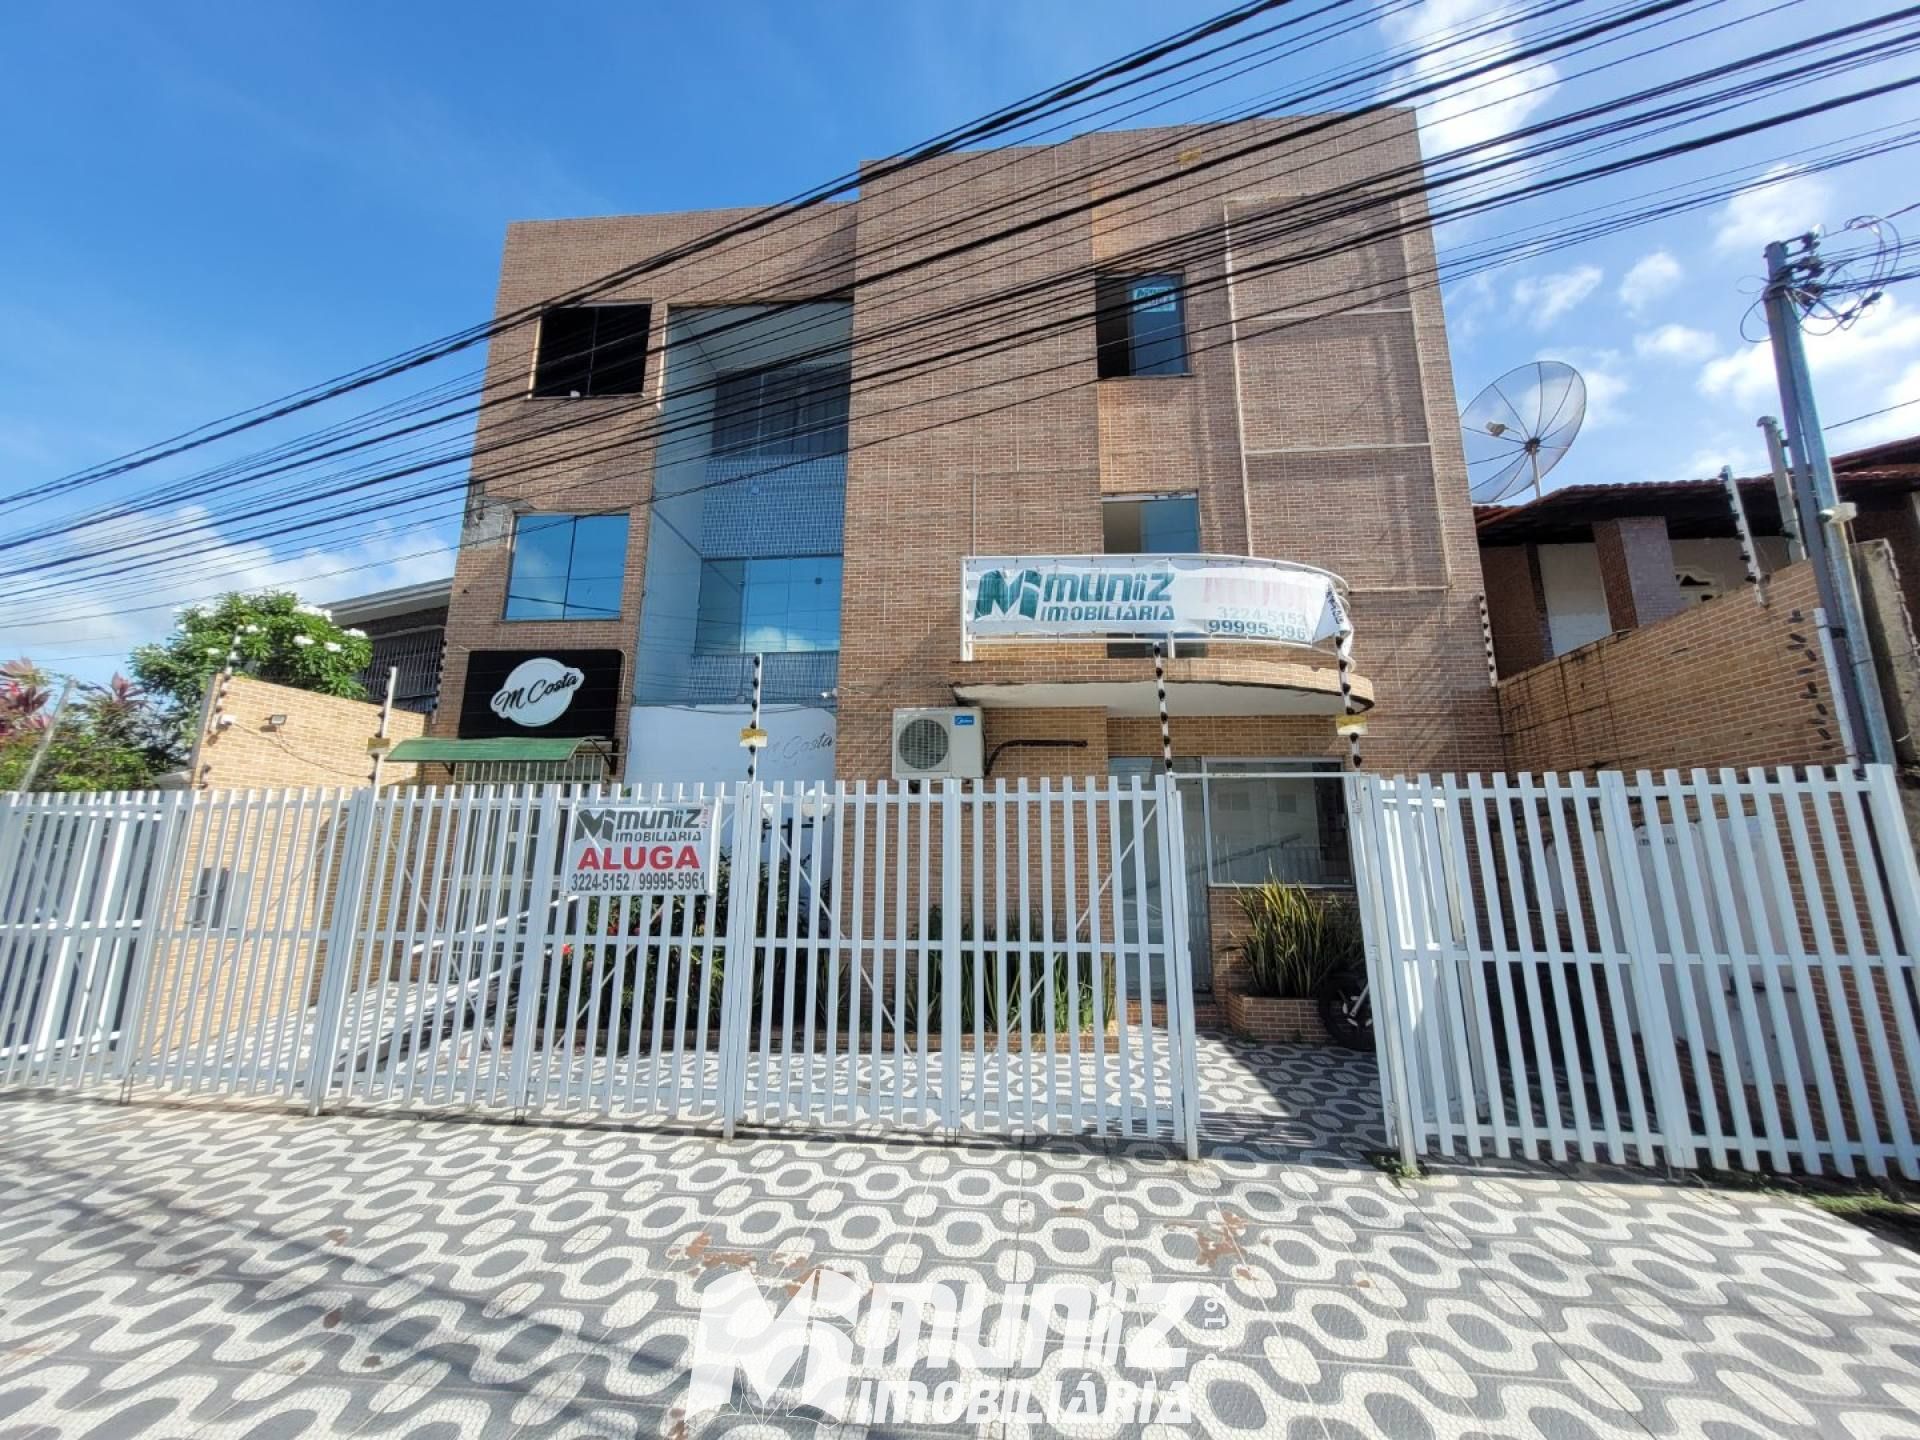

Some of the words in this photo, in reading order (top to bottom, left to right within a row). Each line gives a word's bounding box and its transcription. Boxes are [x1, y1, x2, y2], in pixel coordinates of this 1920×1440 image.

[494, 687, 527, 713] M
[527, 671, 579, 704] Costa
[577, 845, 701, 871] ALUGA
[571, 873, 630, 891] 3224-5152
[639, 872, 705, 891] 99995-5961
